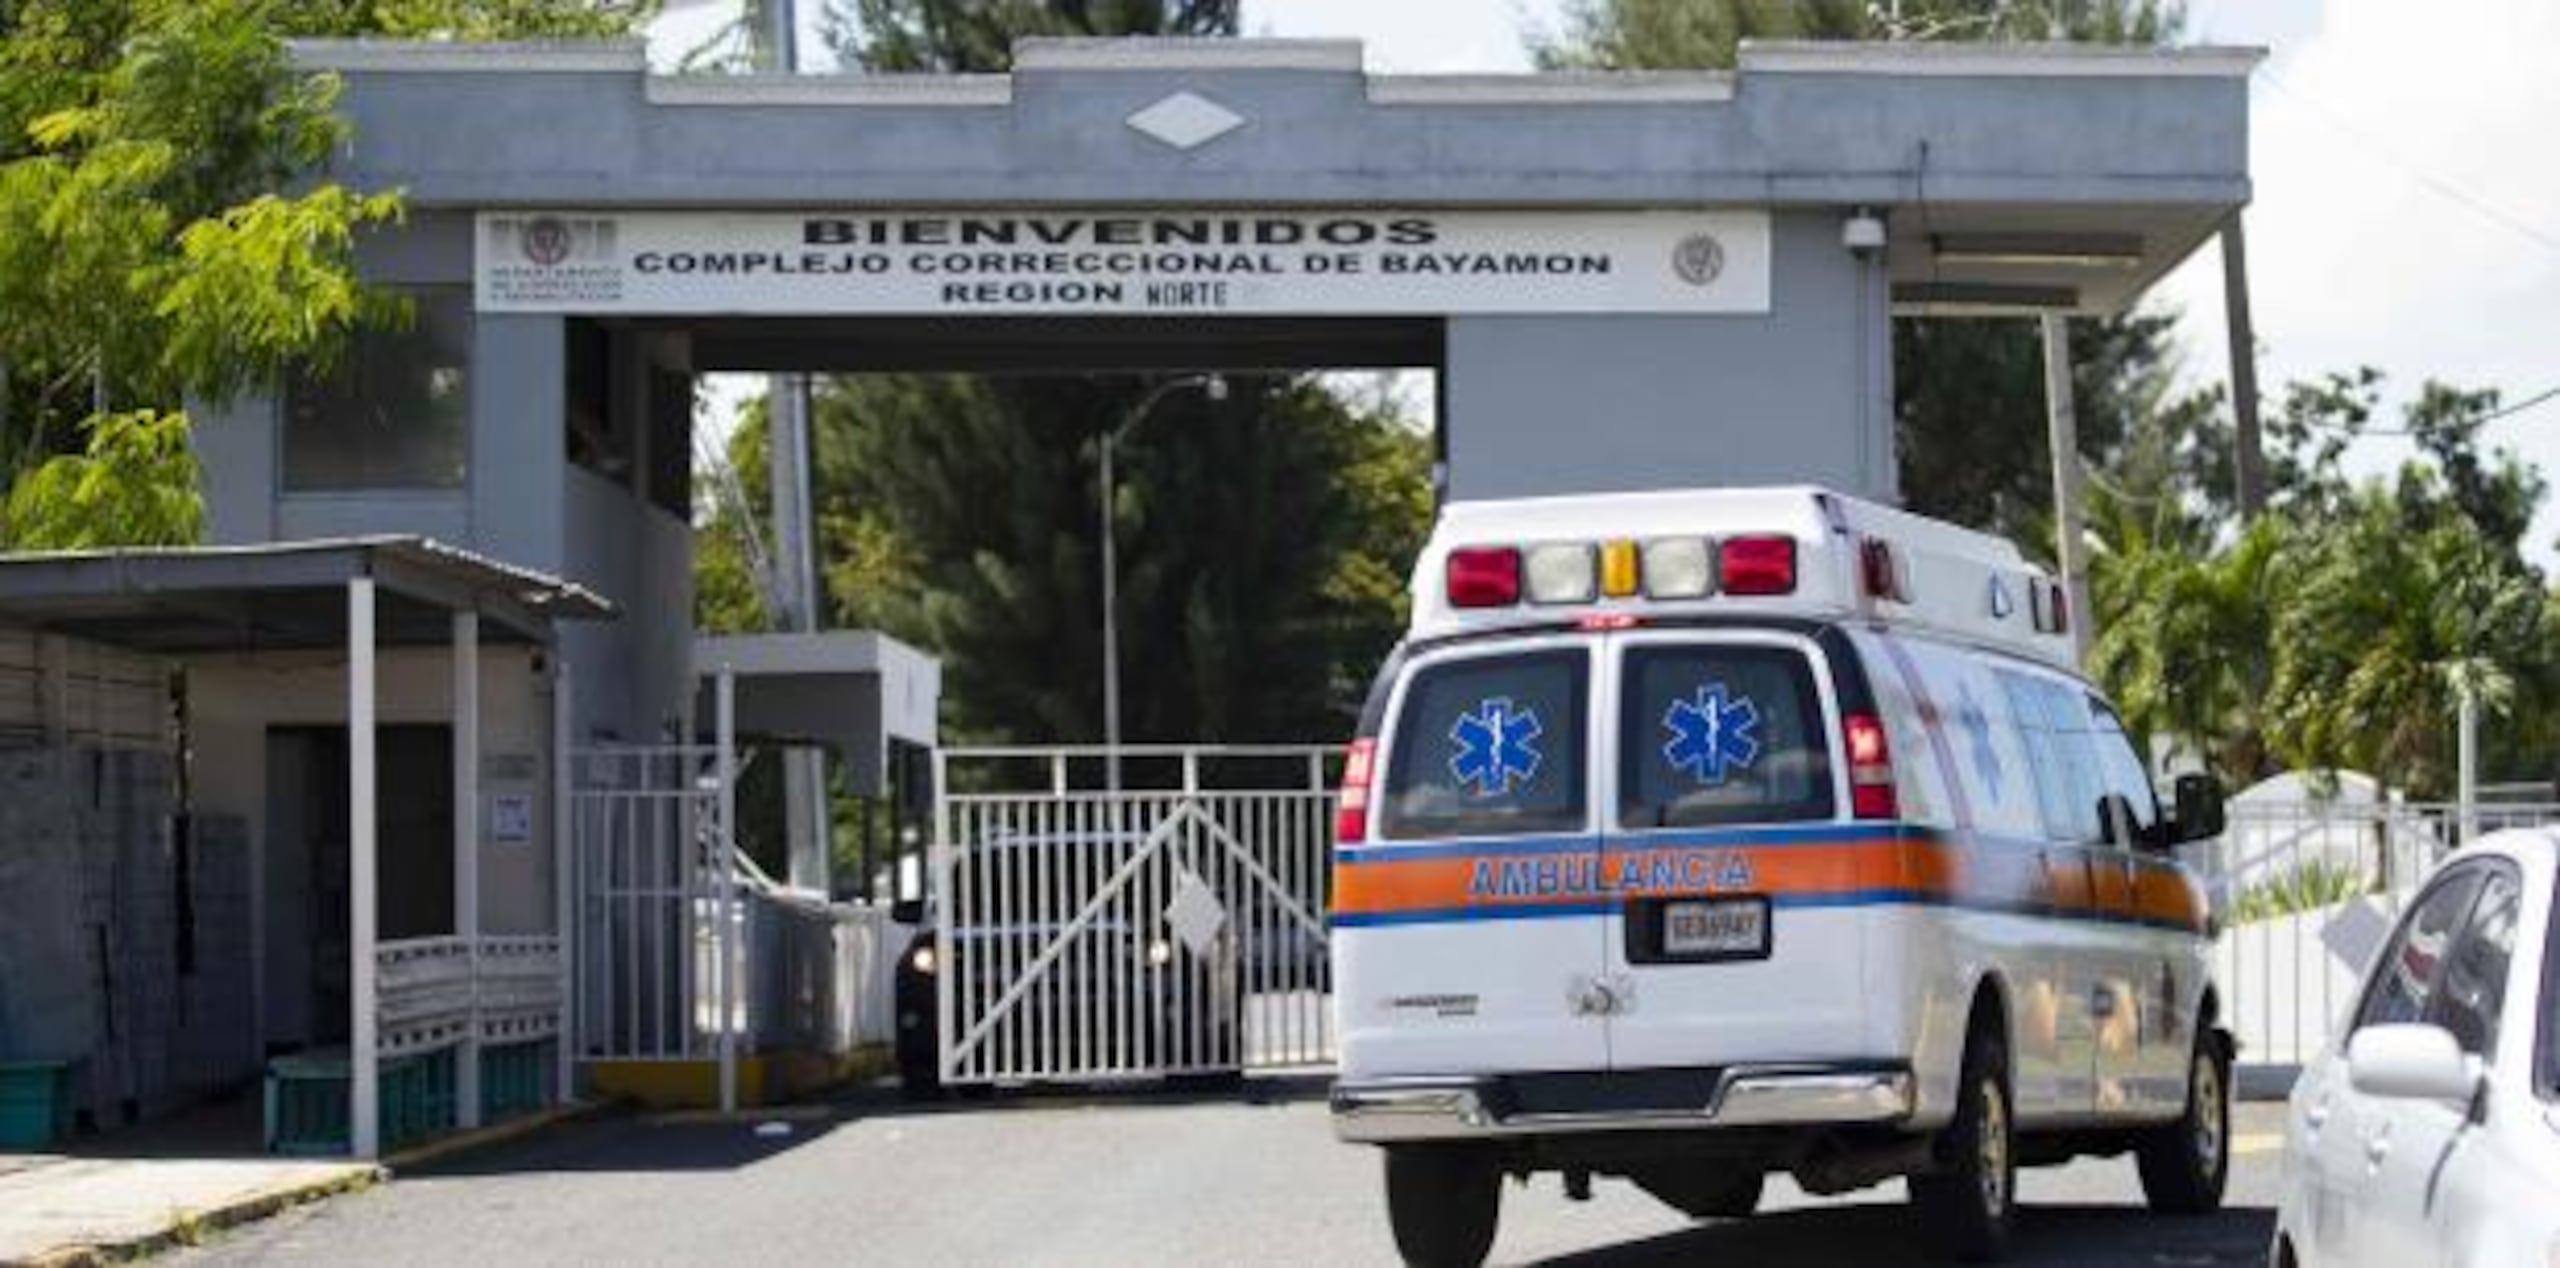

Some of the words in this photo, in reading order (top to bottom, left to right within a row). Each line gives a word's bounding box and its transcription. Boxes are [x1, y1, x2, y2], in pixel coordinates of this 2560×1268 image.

[802, 219, 1438, 245] BIENVENIDOS
[633, 252, 891, 275] COMPLEJO
[907, 252, 1284, 275] CORRECCIONAL
[1304, 253, 1361, 275] DE
[1381, 252, 1612, 275] BAYAMON
[941, 282, 1124, 304] REGION
[1146, 281, 1227, 308] NORTE
[1470, 852, 1754, 896] AMBULANCIA
